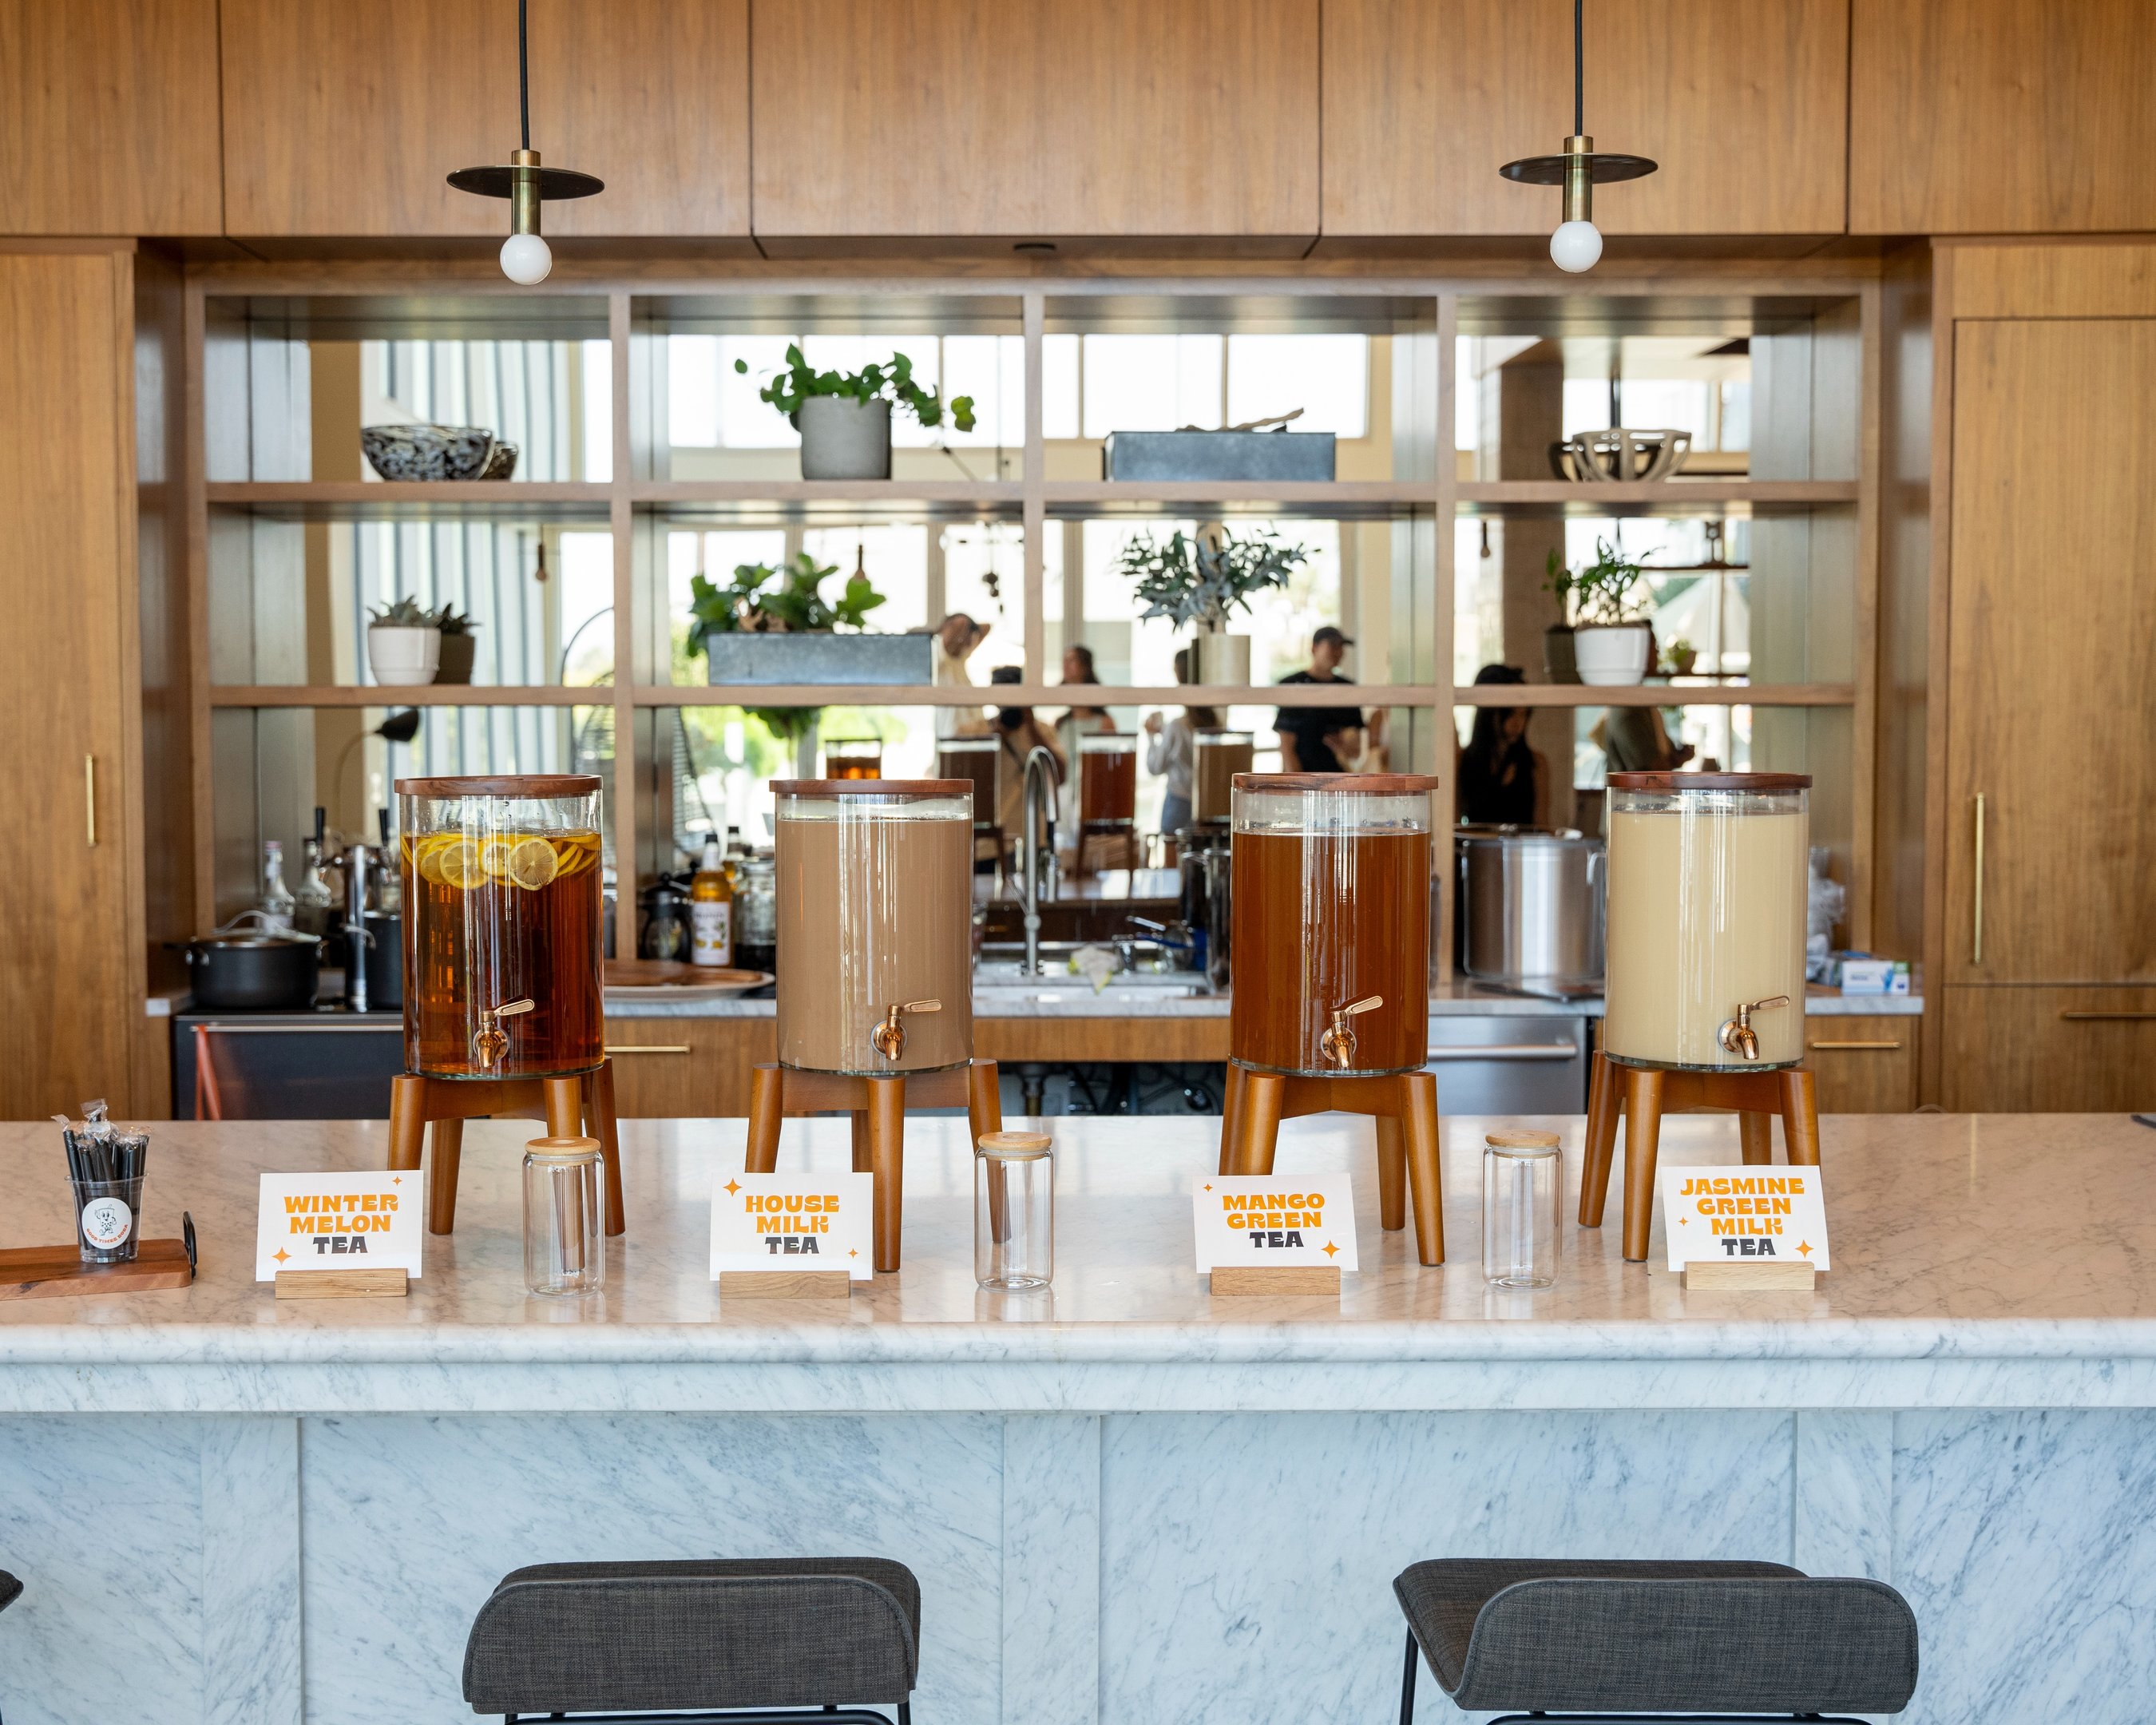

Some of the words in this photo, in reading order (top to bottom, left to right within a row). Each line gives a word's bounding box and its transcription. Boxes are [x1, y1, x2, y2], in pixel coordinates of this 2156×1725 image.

[1680, 1177, 1805, 1196] JASMINE
[283, 1195, 398, 1214] WINTER
[745, 1195, 840, 1213] HOUSE
[1222, 1192, 1326, 1211] MANGO
[1696, 1197, 1792, 1215] GREEN
[290, 1215, 391, 1235] MELON
[756, 1215, 830, 1234] MILK
[1227, 1211, 1322, 1230] GREEN
[1711, 1218, 1783, 1235] MILK
[86, 1228, 98, 1241] GOOD
[117, 1223, 129, 1239] BOBA
[1249, 1231, 1305, 1249] TEA
[312, 1236, 368, 1255] TEA
[765, 1236, 819, 1255] TEA
[1721, 1238, 1776, 1256] TEA
